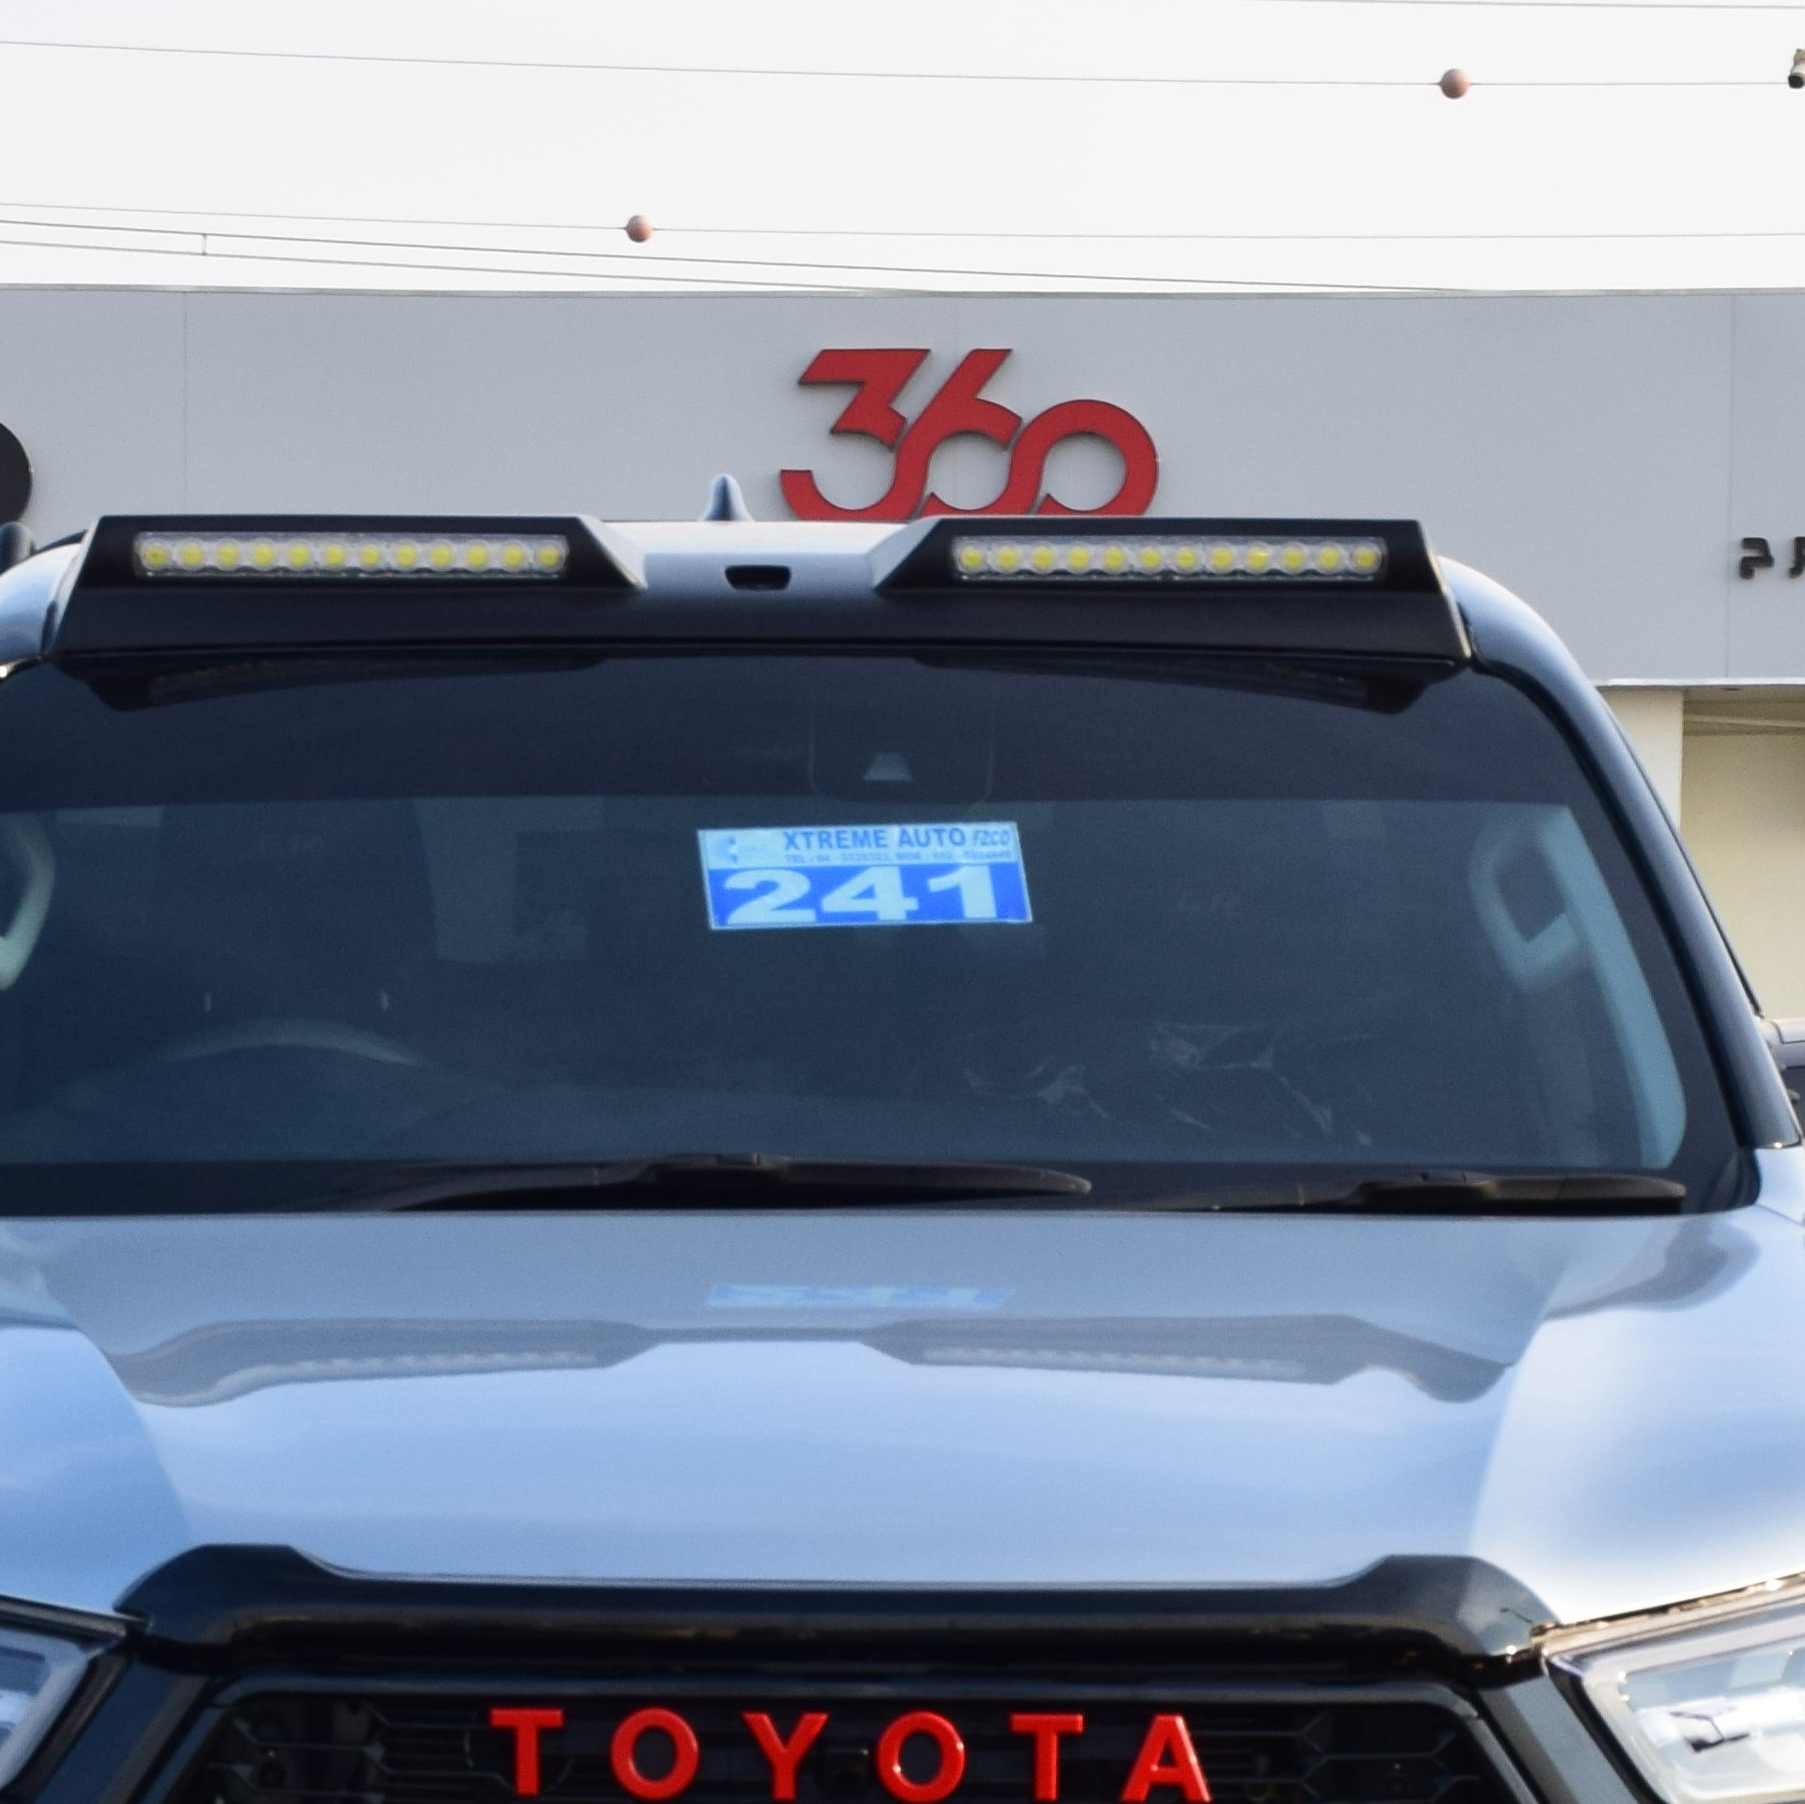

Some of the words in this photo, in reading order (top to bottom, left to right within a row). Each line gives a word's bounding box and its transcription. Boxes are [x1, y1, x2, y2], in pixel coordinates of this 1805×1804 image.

[781, 348, 1159, 519] 360
[783, 828, 889, 851] XTREME
[898, 826, 967, 848] AUTO
[722, 865, 999, 925] 241
[489, 1706, 1213, 1804] TOYOTA
